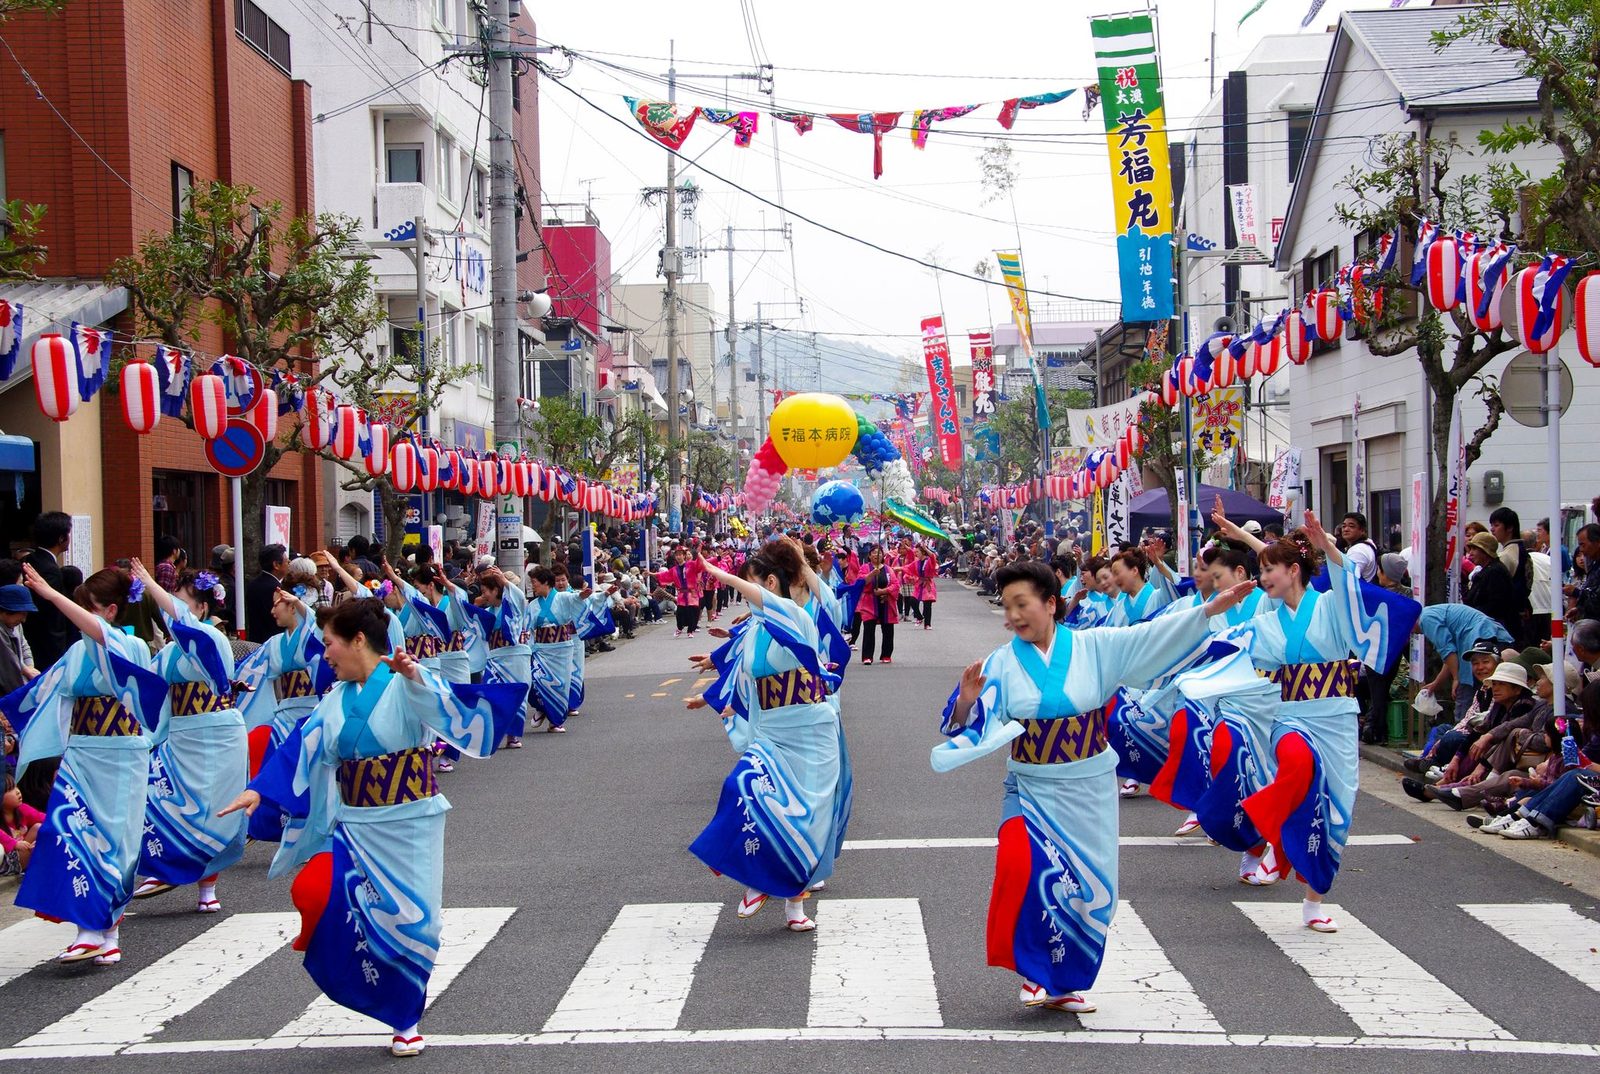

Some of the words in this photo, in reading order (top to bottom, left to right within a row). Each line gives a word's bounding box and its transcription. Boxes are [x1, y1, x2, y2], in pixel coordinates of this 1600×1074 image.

[1115, 66, 1139, 88] 祝
[1117, 108, 1159, 230] 芳福丸
[930, 354, 957, 434] まるさん丸
[1195, 400, 1240, 417] ハイヤ
[1206, 415, 1231, 427] 祭り
[791, 427, 851, 443] 福本病院
